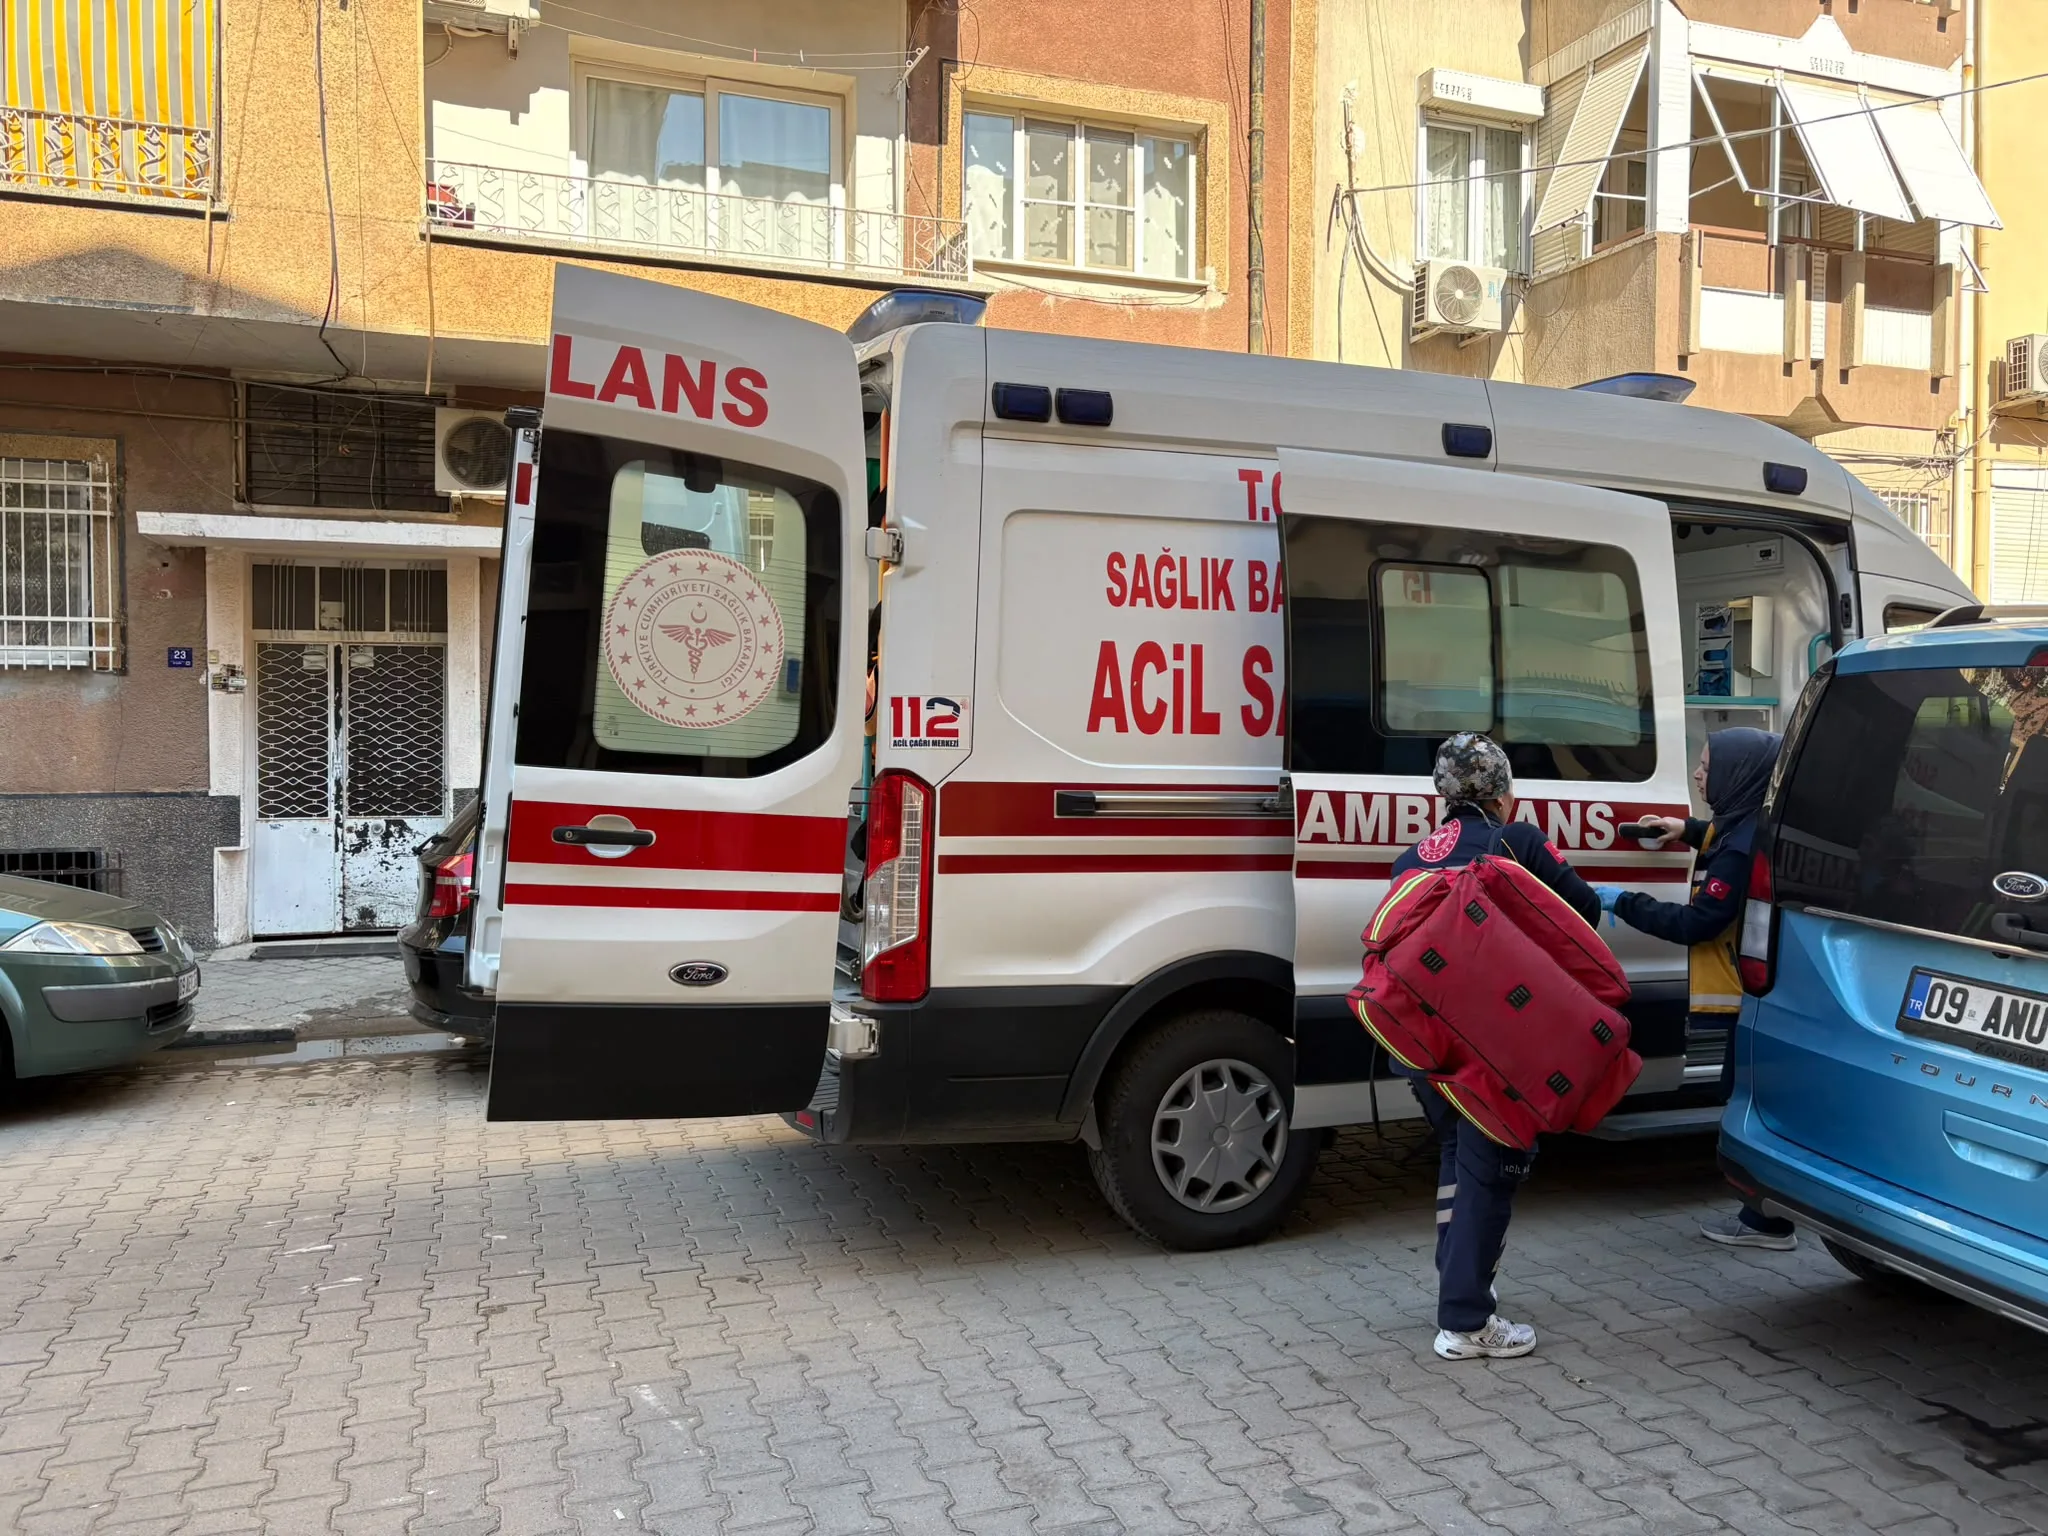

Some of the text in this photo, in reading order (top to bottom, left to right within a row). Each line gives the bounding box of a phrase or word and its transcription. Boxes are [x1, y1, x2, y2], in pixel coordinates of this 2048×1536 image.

[550, 334, 769, 428] LANS
[1106, 546, 1236, 612] SAĞLIK
[713, 583, 749, 625] SAĞLIK
[174, 650, 187, 660] 23
[1241, 645, 1285, 737] S
[890, 697, 961, 738] 112
[1298, 791, 1616, 850] AMBANS
[2003, 877, 2034, 894] Ford
[683, 966, 716, 980] Ford
[1909, 999, 1922, 1012] TR
[1925, 982, 1970, 1025] 09
